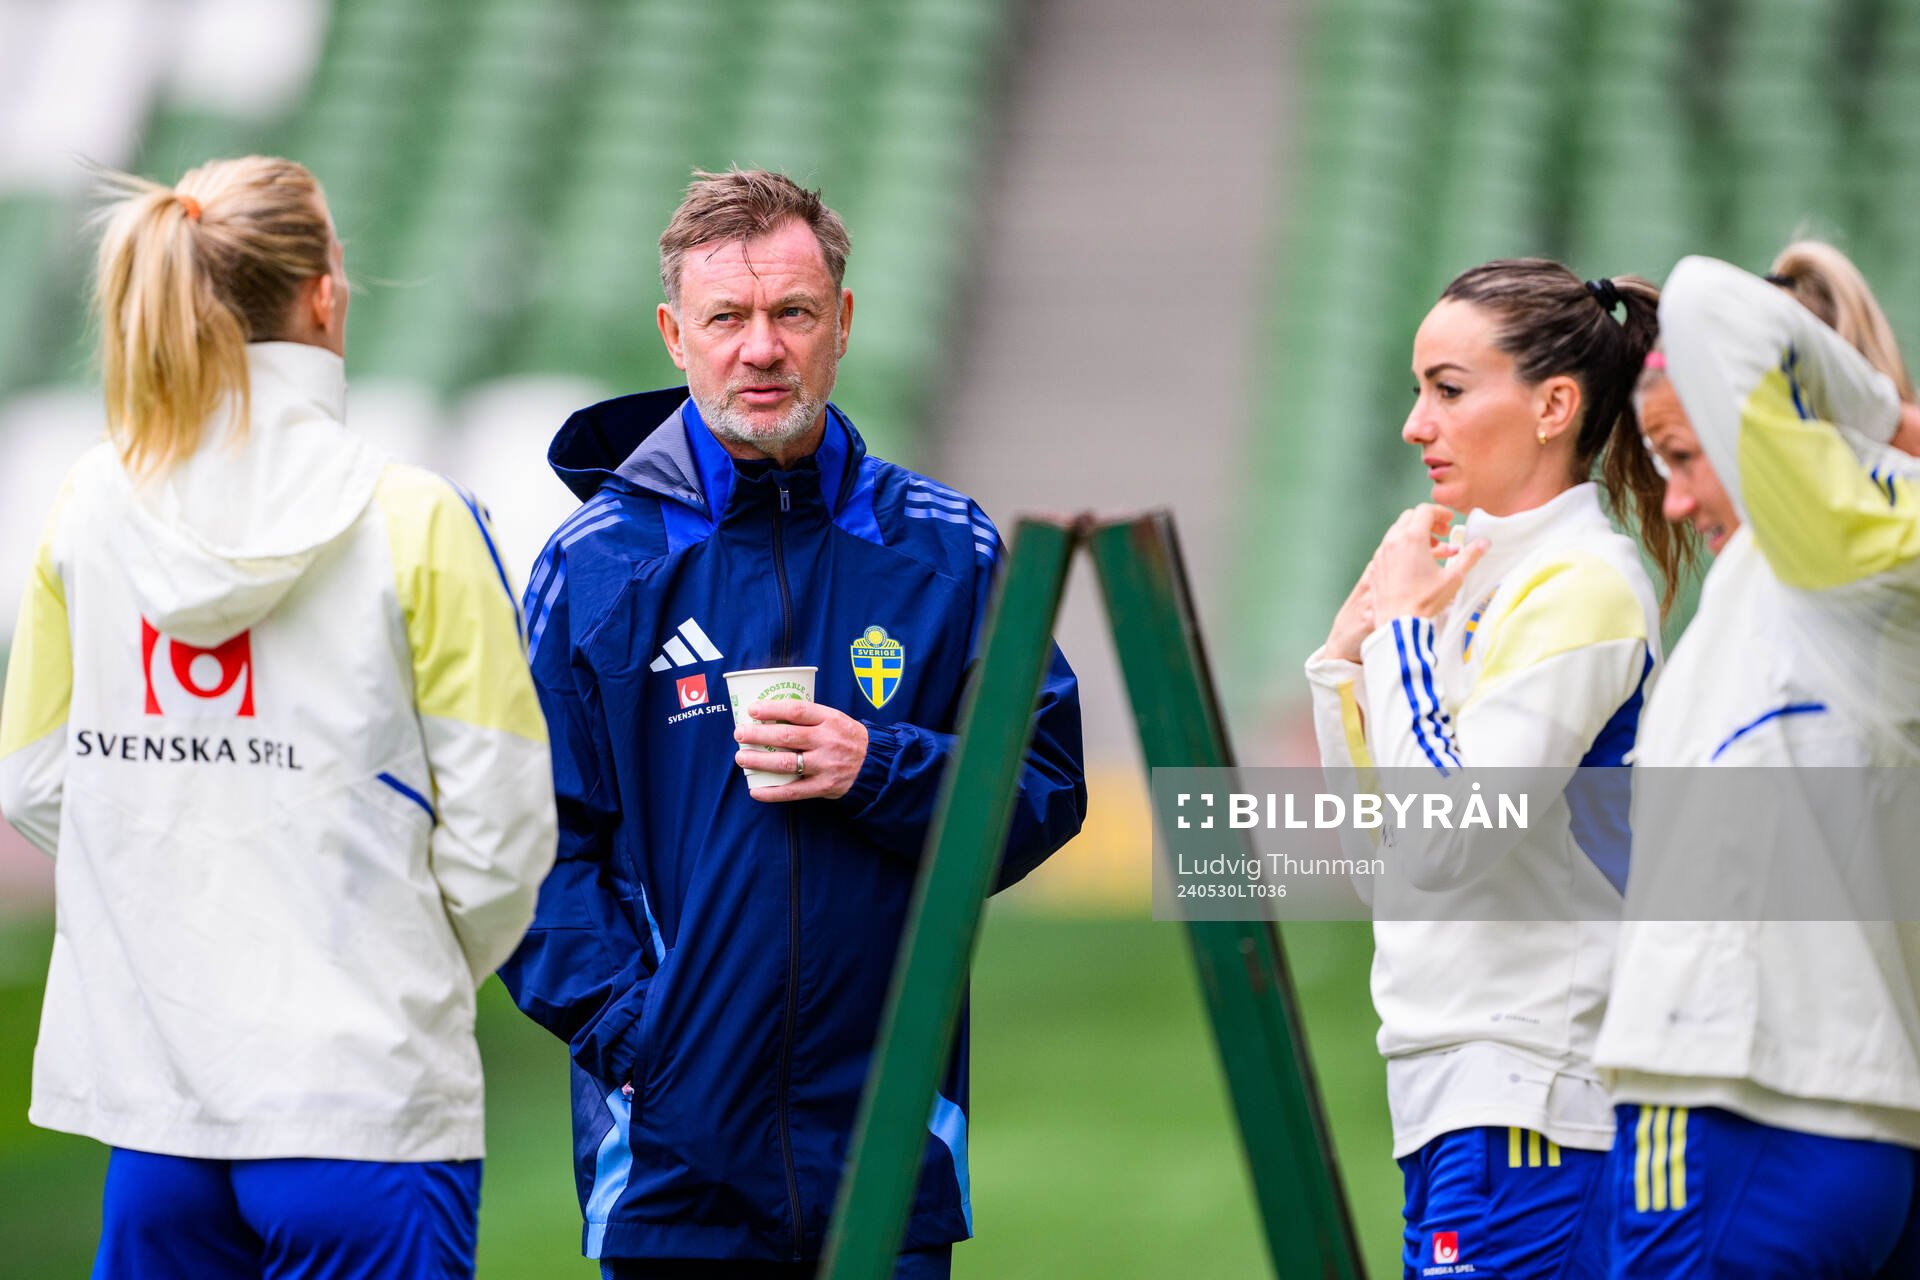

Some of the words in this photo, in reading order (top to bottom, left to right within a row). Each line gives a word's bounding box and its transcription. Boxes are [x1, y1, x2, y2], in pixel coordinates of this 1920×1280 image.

[857, 649, 896, 657] SVERIGE
[757, 681, 806, 701] MPOSTABLE
[668, 707, 705, 725] SVENSKA
[705, 703, 728, 714] SPEL
[76, 730, 235, 763] SVENSKA
[248, 738, 303, 770] SPEL
